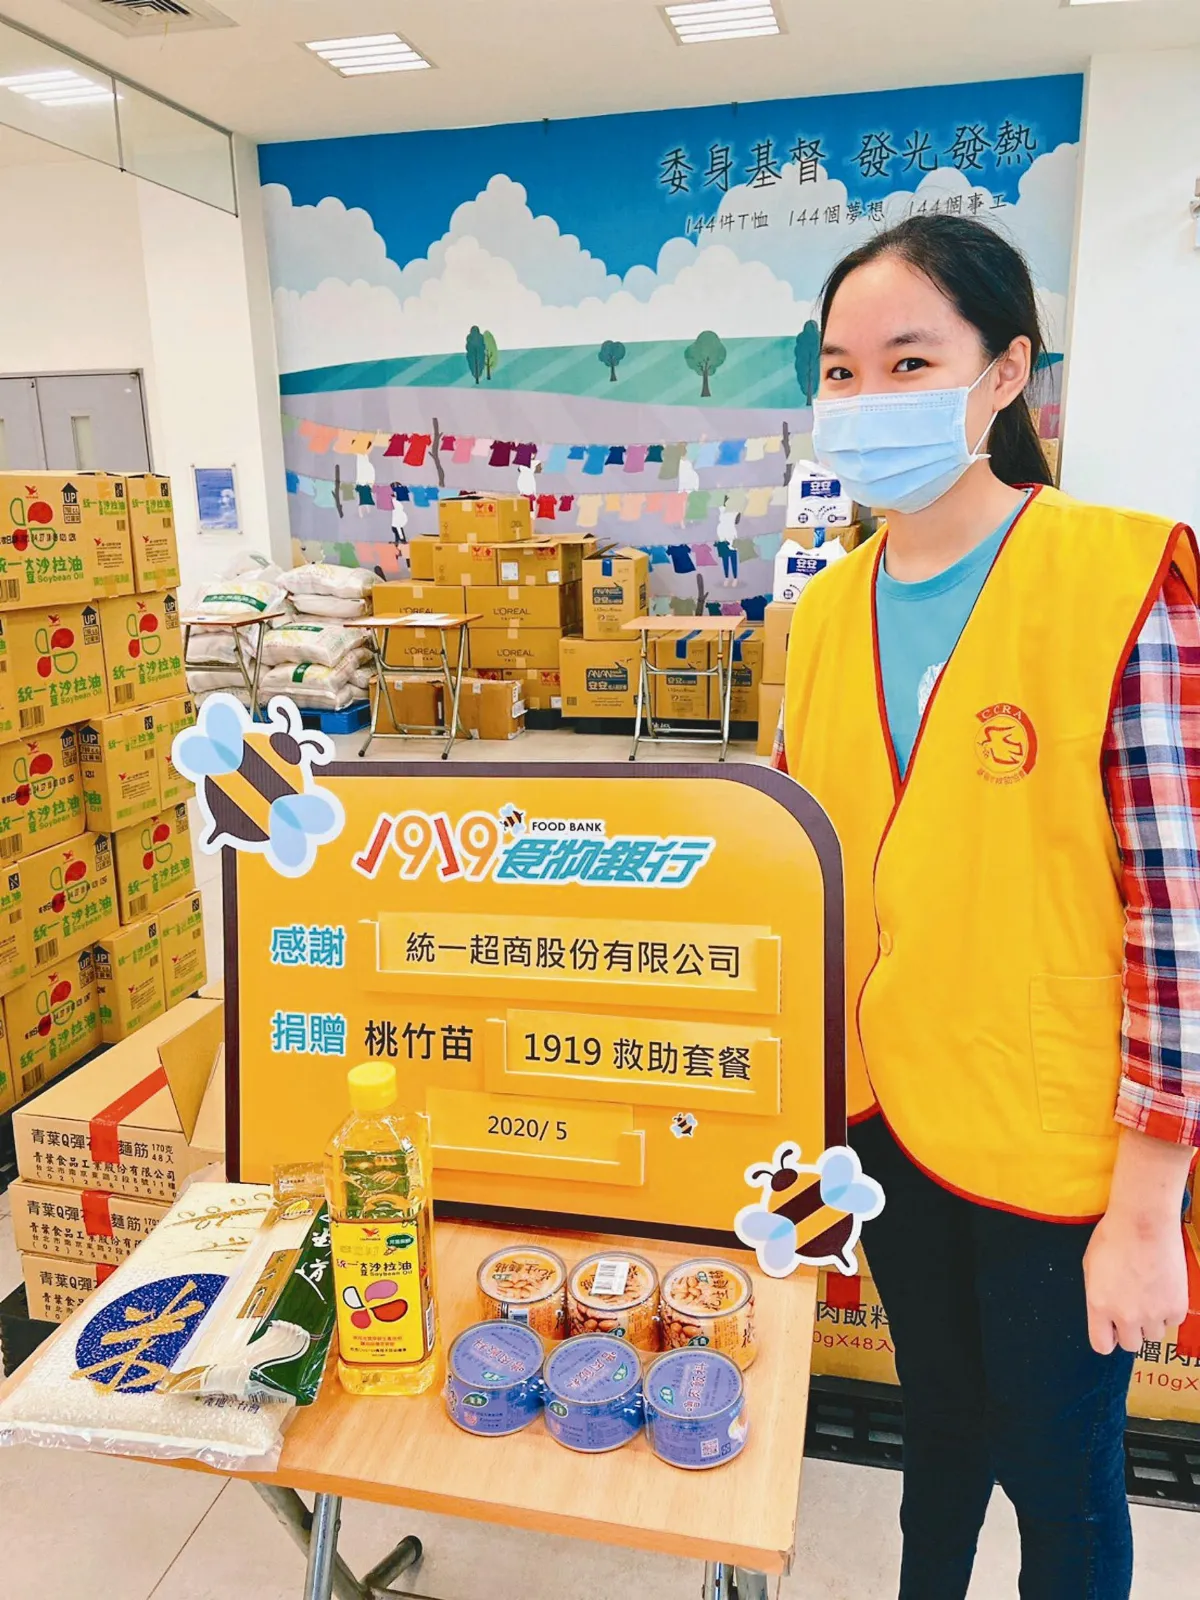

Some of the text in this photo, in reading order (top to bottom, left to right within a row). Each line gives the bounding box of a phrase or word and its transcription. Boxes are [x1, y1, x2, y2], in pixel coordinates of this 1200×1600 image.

[659, 120, 1038, 195] 委身基督 發光發熱
[685, 213, 769, 234] 144件T恤
[788, 201, 886, 226] 144個夢想
[65, 491, 76, 503] UP
[38, 573, 72, 584] Soybean
[165, 602, 175, 612] UP
[84, 614, 95, 625] UP
[981, 705, 1023, 721] CCRA
[62, 735, 73, 747] UP
[82, 734, 97, 744] UP
[532, 822, 602, 832] FOOD BANK
[497, 838, 710, 883] 食物銀行
[271, 926, 740, 978] 感謝 統一超商股份有限公司
[272, 1012, 752, 1081] 捐贈 桃竹苗 1919 救助套餐
